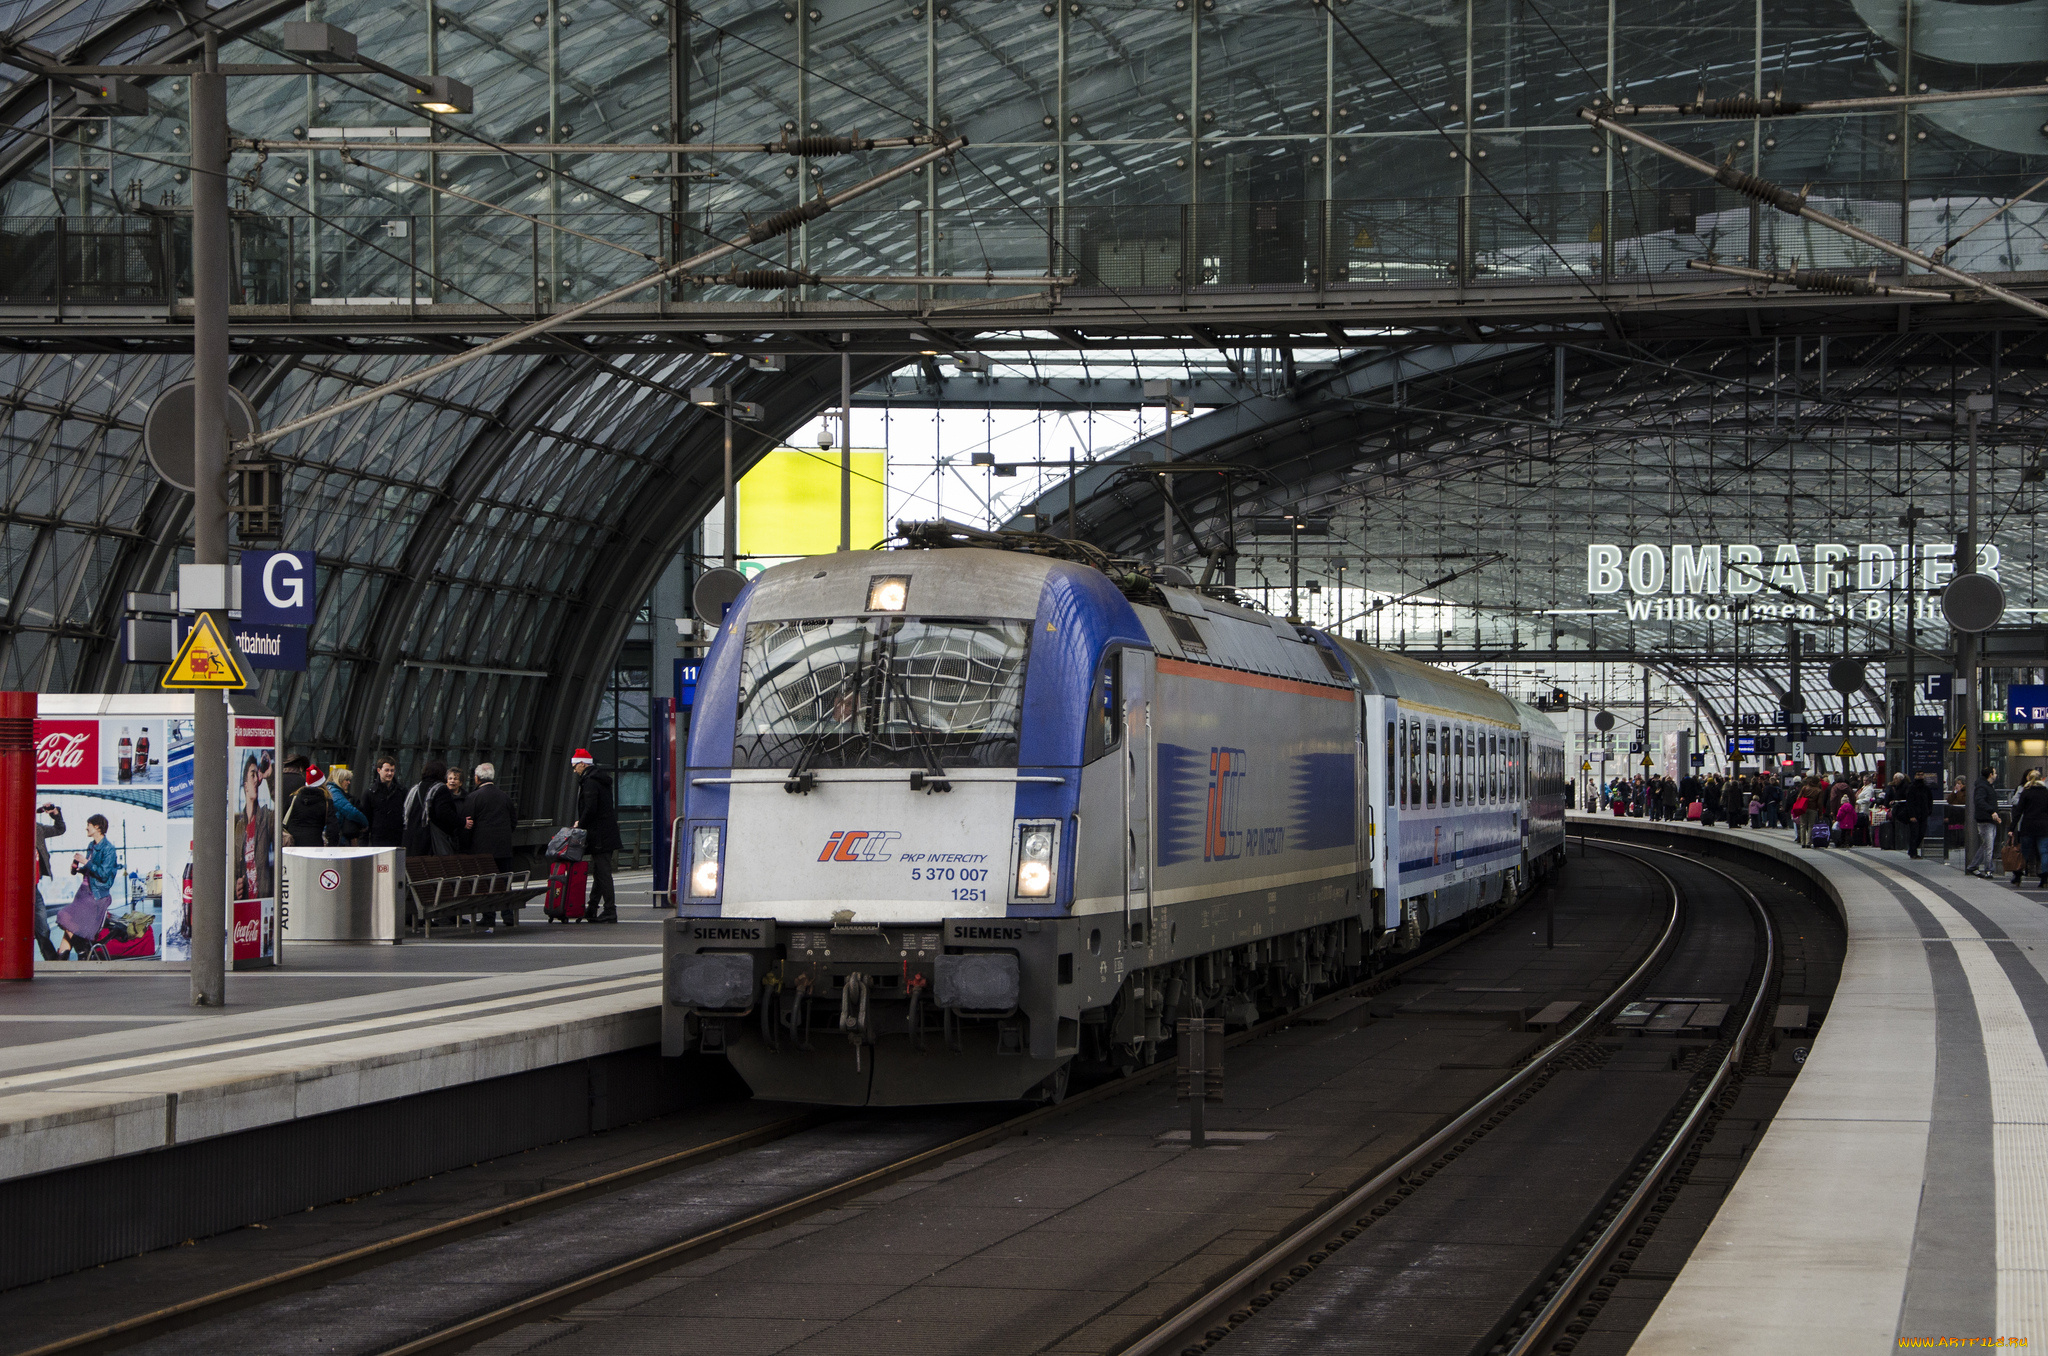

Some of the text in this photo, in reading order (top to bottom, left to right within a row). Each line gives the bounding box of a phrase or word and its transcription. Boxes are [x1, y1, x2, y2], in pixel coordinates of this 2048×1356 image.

[1588, 544, 2000, 595] BOMBARDIER
[262, 552, 304, 608] G
[1625, 598, 1815, 621] Willkommen
[682, 666, 696, 680] 11
[1927, 674, 1941, 695] F
[1743, 715, 1757, 725] 13
[1775, 711, 1785, 724] E
[1828, 715, 1840, 725] 14
[1631, 743, 1639, 752] D
[1757, 736, 1771, 749] 13
[900, 853, 926, 862] PKP
[927, 854, 988, 863] INTERCITY
[911, 867, 989, 882] 5 370 007
[951, 888, 986, 901] 1251
[694, 927, 760, 940] SIEMENS
[954, 926, 1022, 940] SIEMENS
